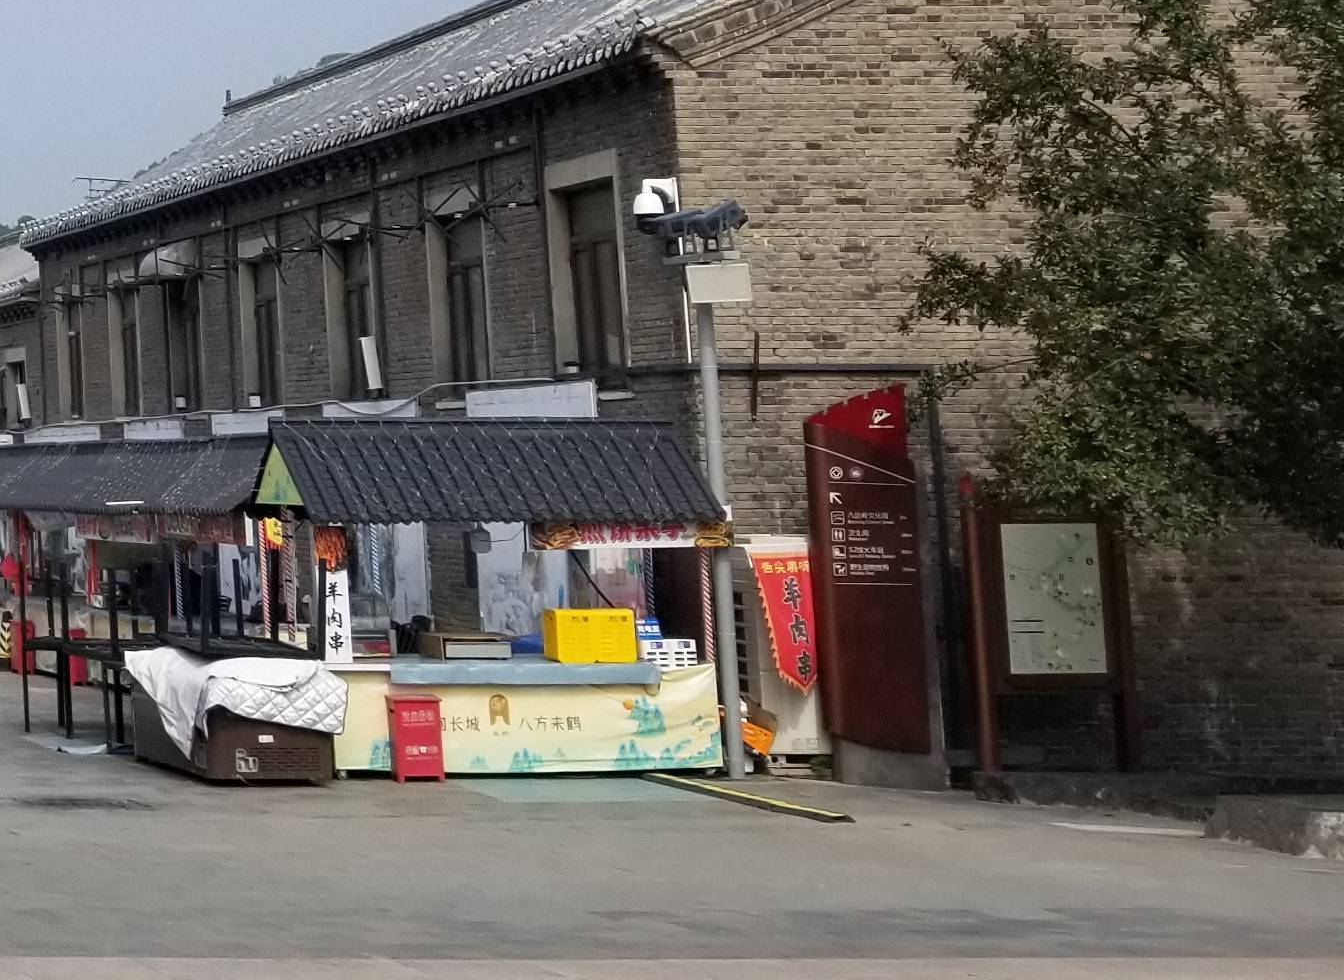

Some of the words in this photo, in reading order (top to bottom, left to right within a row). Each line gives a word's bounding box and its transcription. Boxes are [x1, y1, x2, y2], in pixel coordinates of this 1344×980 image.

[325, 581, 344, 656] 羊肉串
[782, 576, 811, 681] 羊肉串
